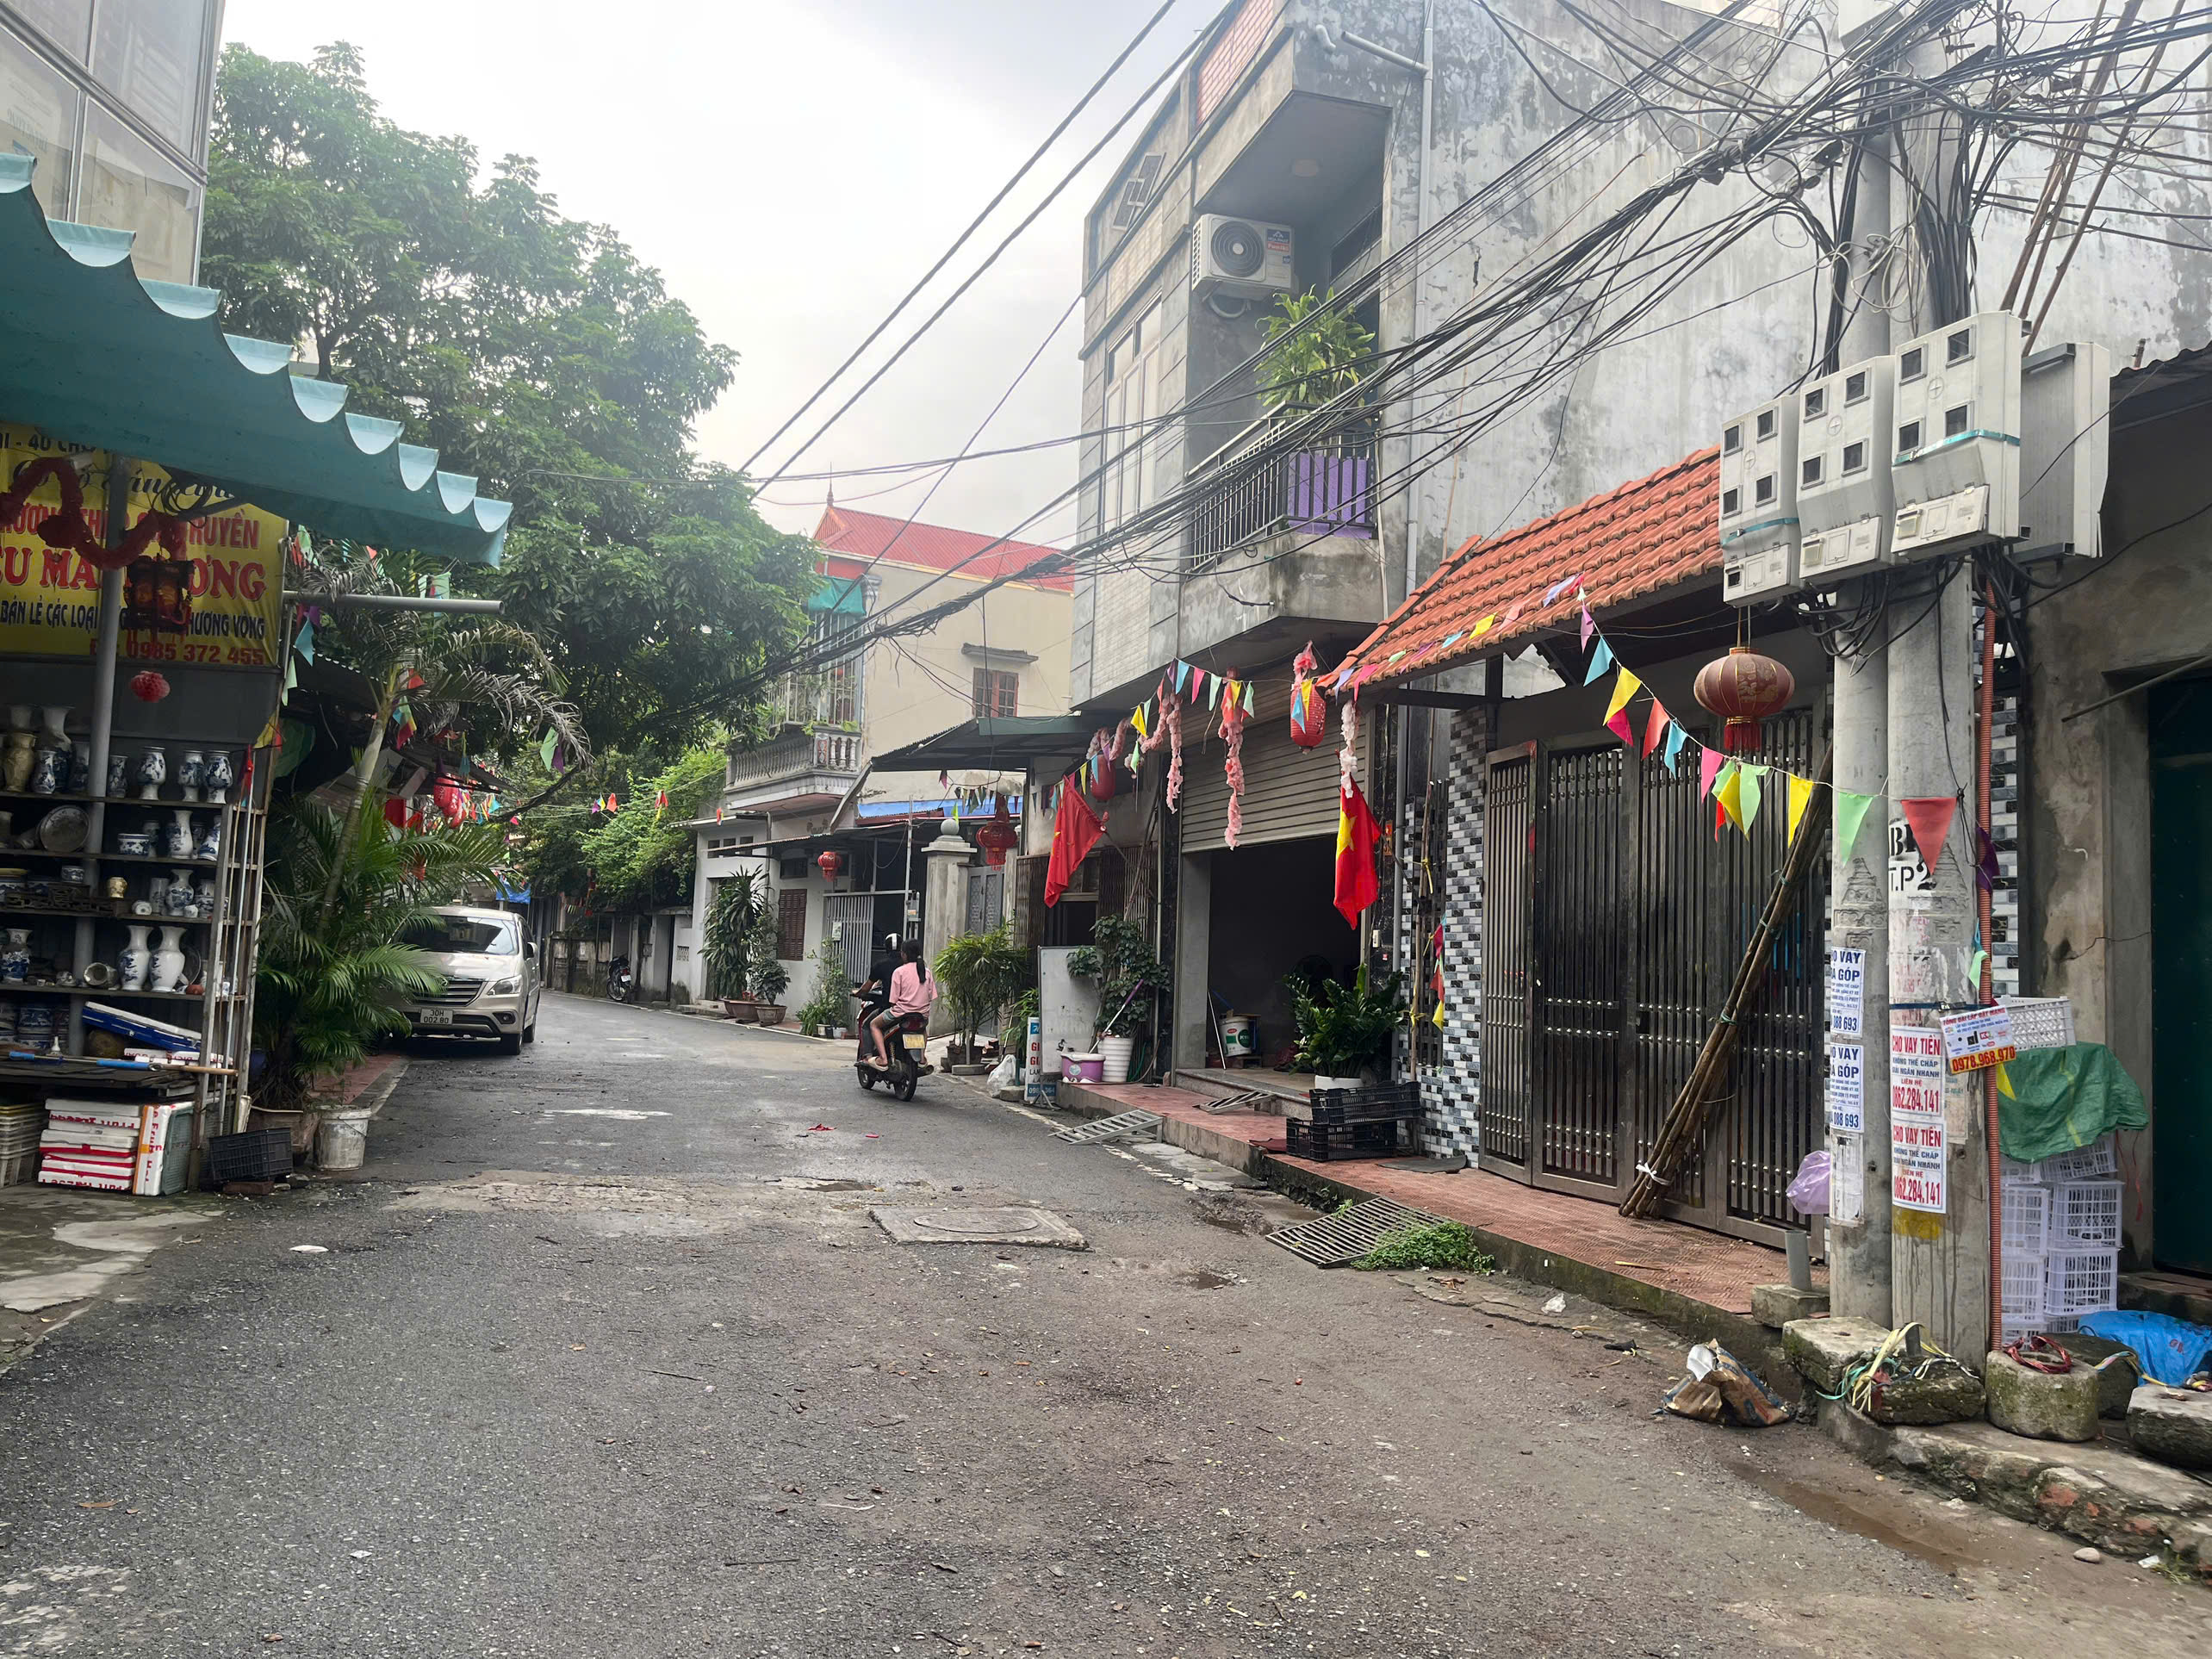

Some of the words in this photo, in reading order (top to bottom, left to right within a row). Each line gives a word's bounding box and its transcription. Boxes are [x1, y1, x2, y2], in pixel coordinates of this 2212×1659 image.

[1, 594, 26, 625] BÁN
[47, 598, 68, 629] CÁC
[71, 604, 99, 633] LOẠI
[183, 643, 221, 662] 372
[227, 647, 264, 665] 455
[1840, 950, 1861, 964] VAY
[1838, 966, 1860, 982] GÓP
[1843, 1016, 1857, 1031] 693
[1904, 1036, 1917, 1053] VAY
[1920, 1035, 1941, 1055] TIỀN
[1838, 1047, 1859, 1060] VAY
[1952, 1046, 2016, 1072] 0978.968.970
[1837, 1063, 1859, 1078] GÓP
[1916, 1069, 1940, 1078] NHANH
[1844, 1113, 1859, 1128] 693
[1904, 1127, 1918, 1145] VAY
[1920, 1125, 1941, 1147] TIỀN
[1917, 1160, 1941, 1170] NHANH
